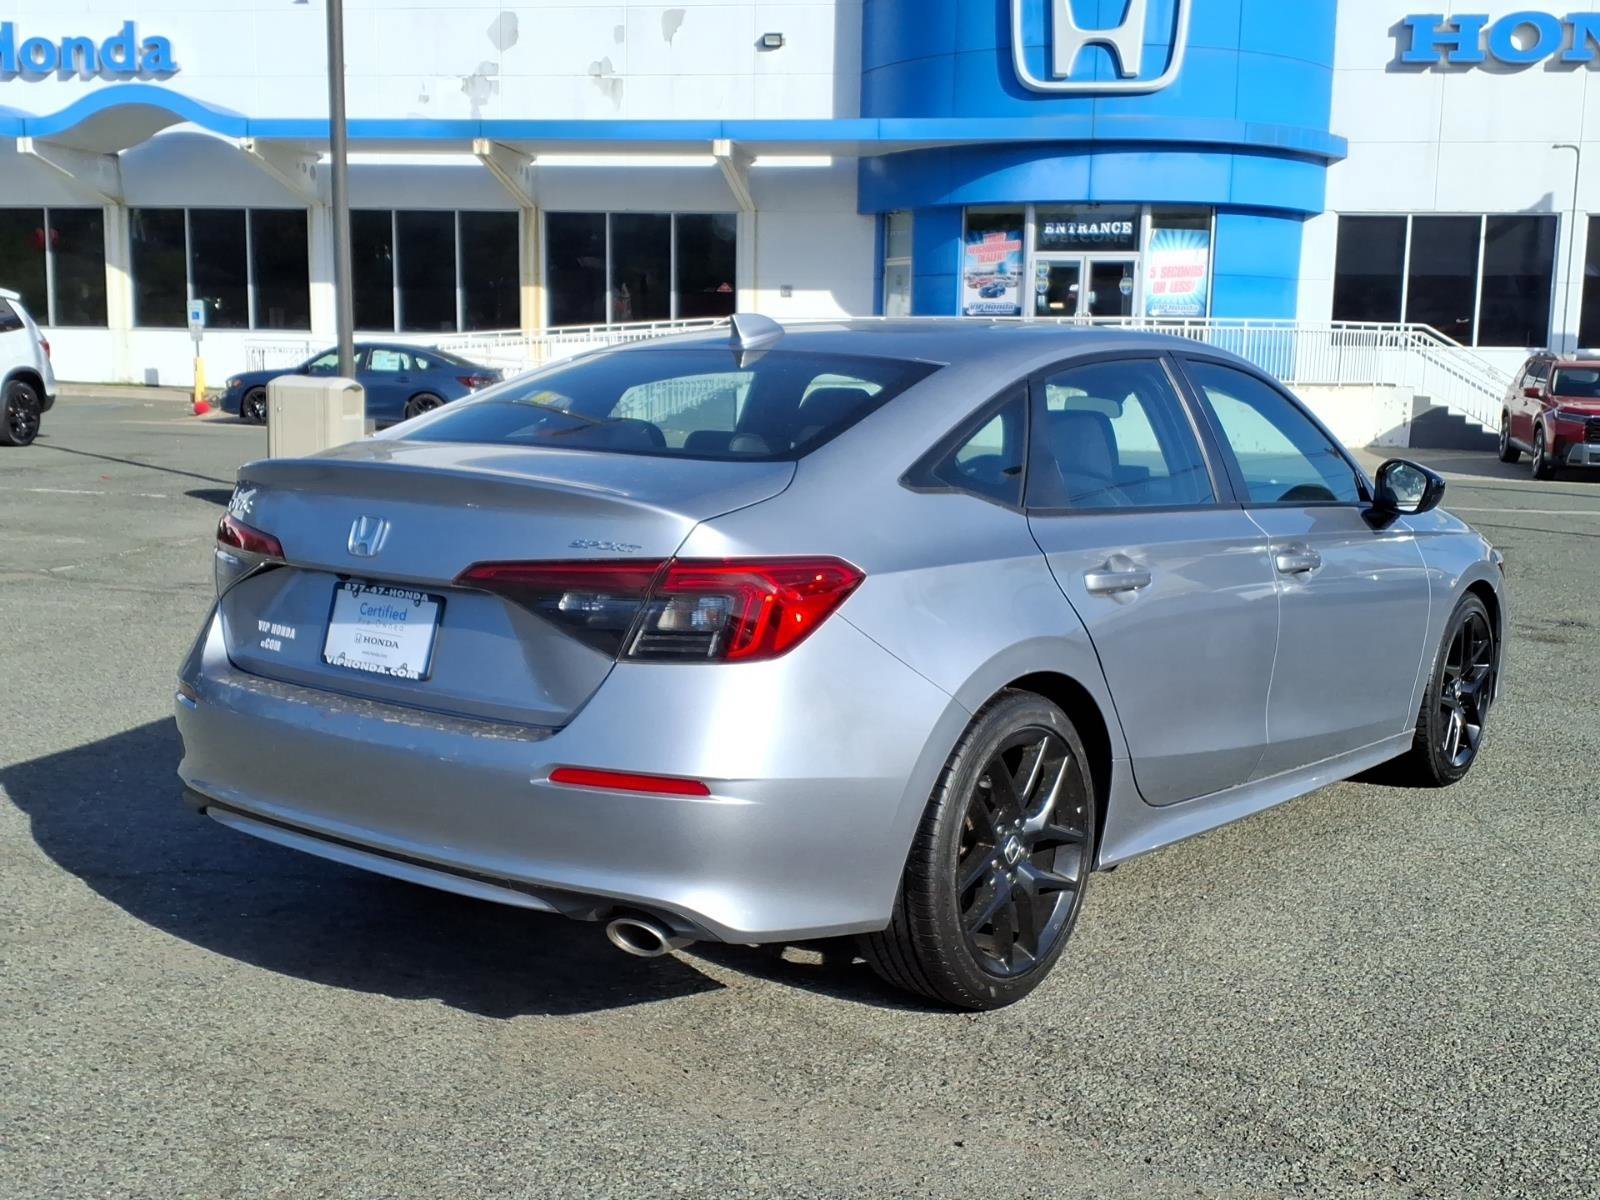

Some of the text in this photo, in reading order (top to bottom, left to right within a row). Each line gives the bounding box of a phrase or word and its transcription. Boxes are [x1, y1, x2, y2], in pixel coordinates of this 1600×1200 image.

[1044, 221, 1133, 234] ENTRANCE
[1160, 264, 1204, 278] SECONDS
[344, 583, 429, 602] 877-47-HONDA
[360, 602, 407, 621] Certified
[258, 620, 296, 639] VIP HONDA
[363, 637, 399, 649] HONDA
[326, 656, 419, 680] VIPHONDA.COM
